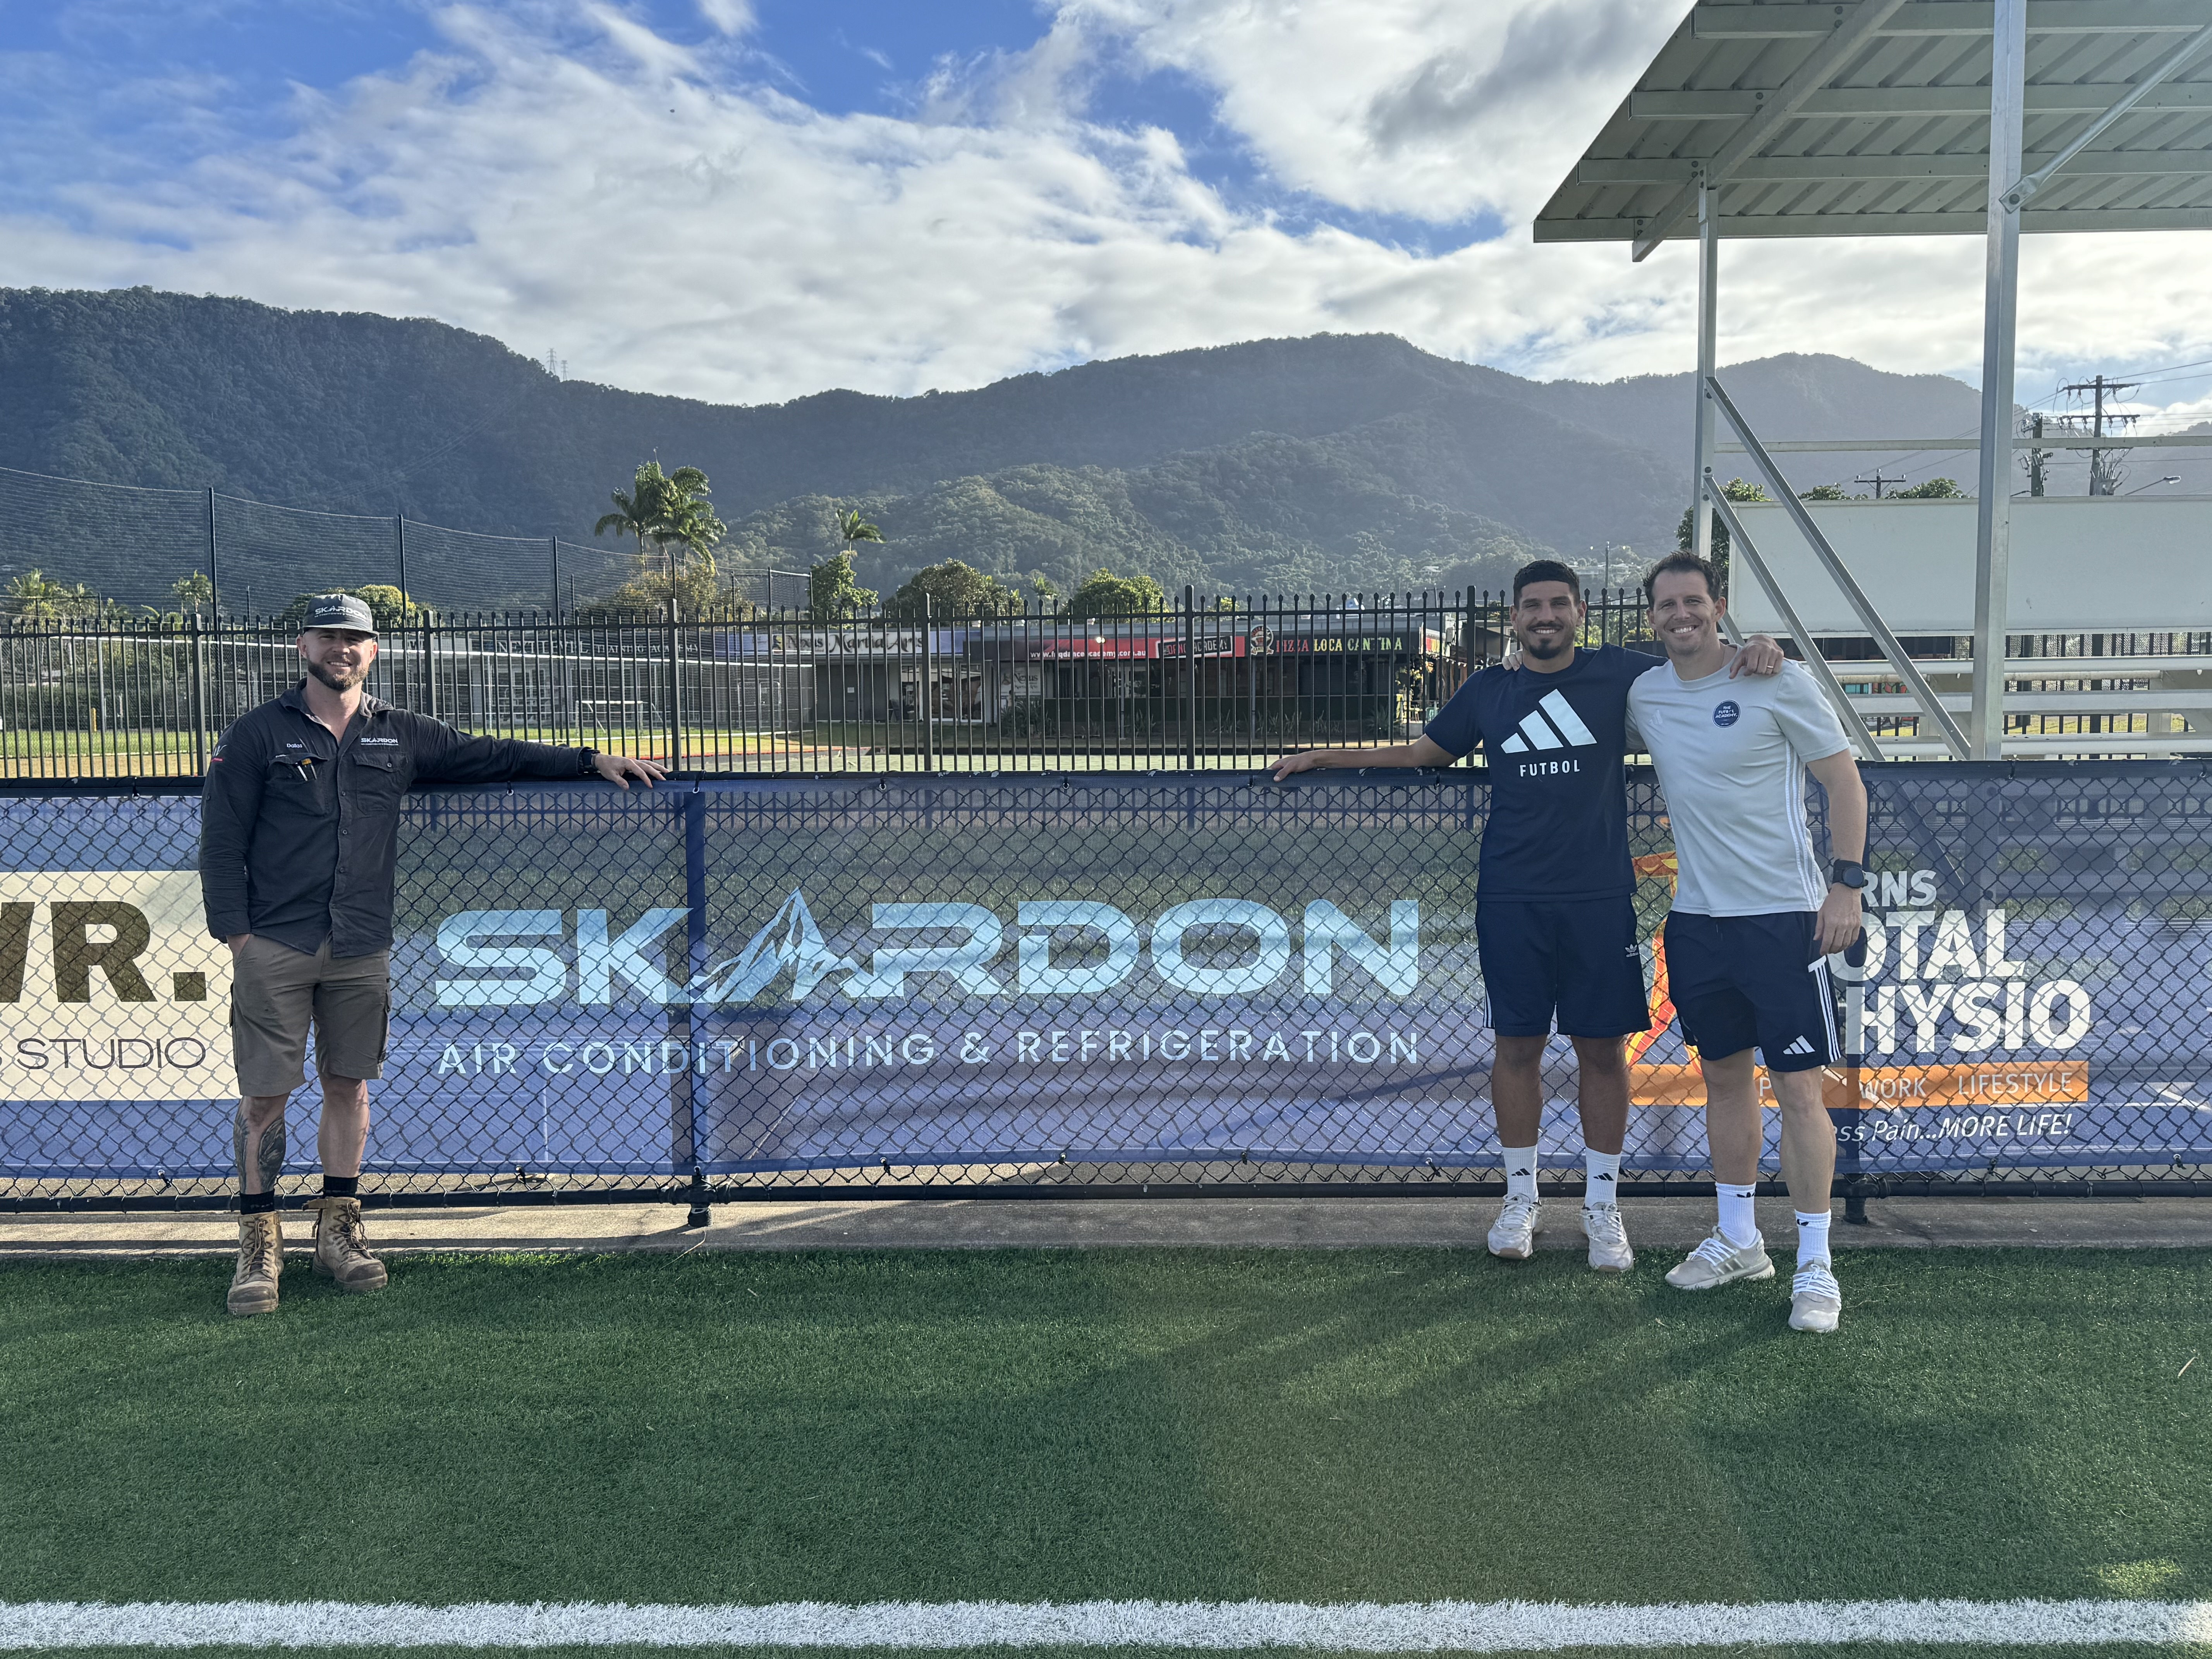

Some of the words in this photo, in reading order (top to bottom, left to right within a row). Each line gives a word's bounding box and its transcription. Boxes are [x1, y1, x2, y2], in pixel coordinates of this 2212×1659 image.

[315, 605, 367, 619] SKARDON
[651, 644, 699, 653] ACAEMY
[887, 635, 922, 652] Ars
[1313, 638, 1343, 652] LOCA
[1014, 673, 1038, 684] Neus
[1520, 759, 1580, 777] FUTBOL
[1862, 870, 1936, 907] RNS
[0, 901, 207, 1003] R.
[436, 886, 1419, 1006] SKARDON
[1827, 909, 2026, 981] OTAL
[1846, 979, 2090, 1054] HYSIO
[17, 1037, 206, 1069] STUDIO
[438, 1042, 517, 1074] AIR
[543, 1032, 934, 1074] CONDITIONING
[960, 1031, 991, 1064] &
[1018, 1030, 1417, 1064] REFRIGERATION
[1858, 1077, 1927, 1099] WORK
[1958, 1072, 2073, 1095] LIFESTYLE
[1833, 1125, 1865, 1142] ss
[2017, 1113, 2073, 1136] LIFE!
